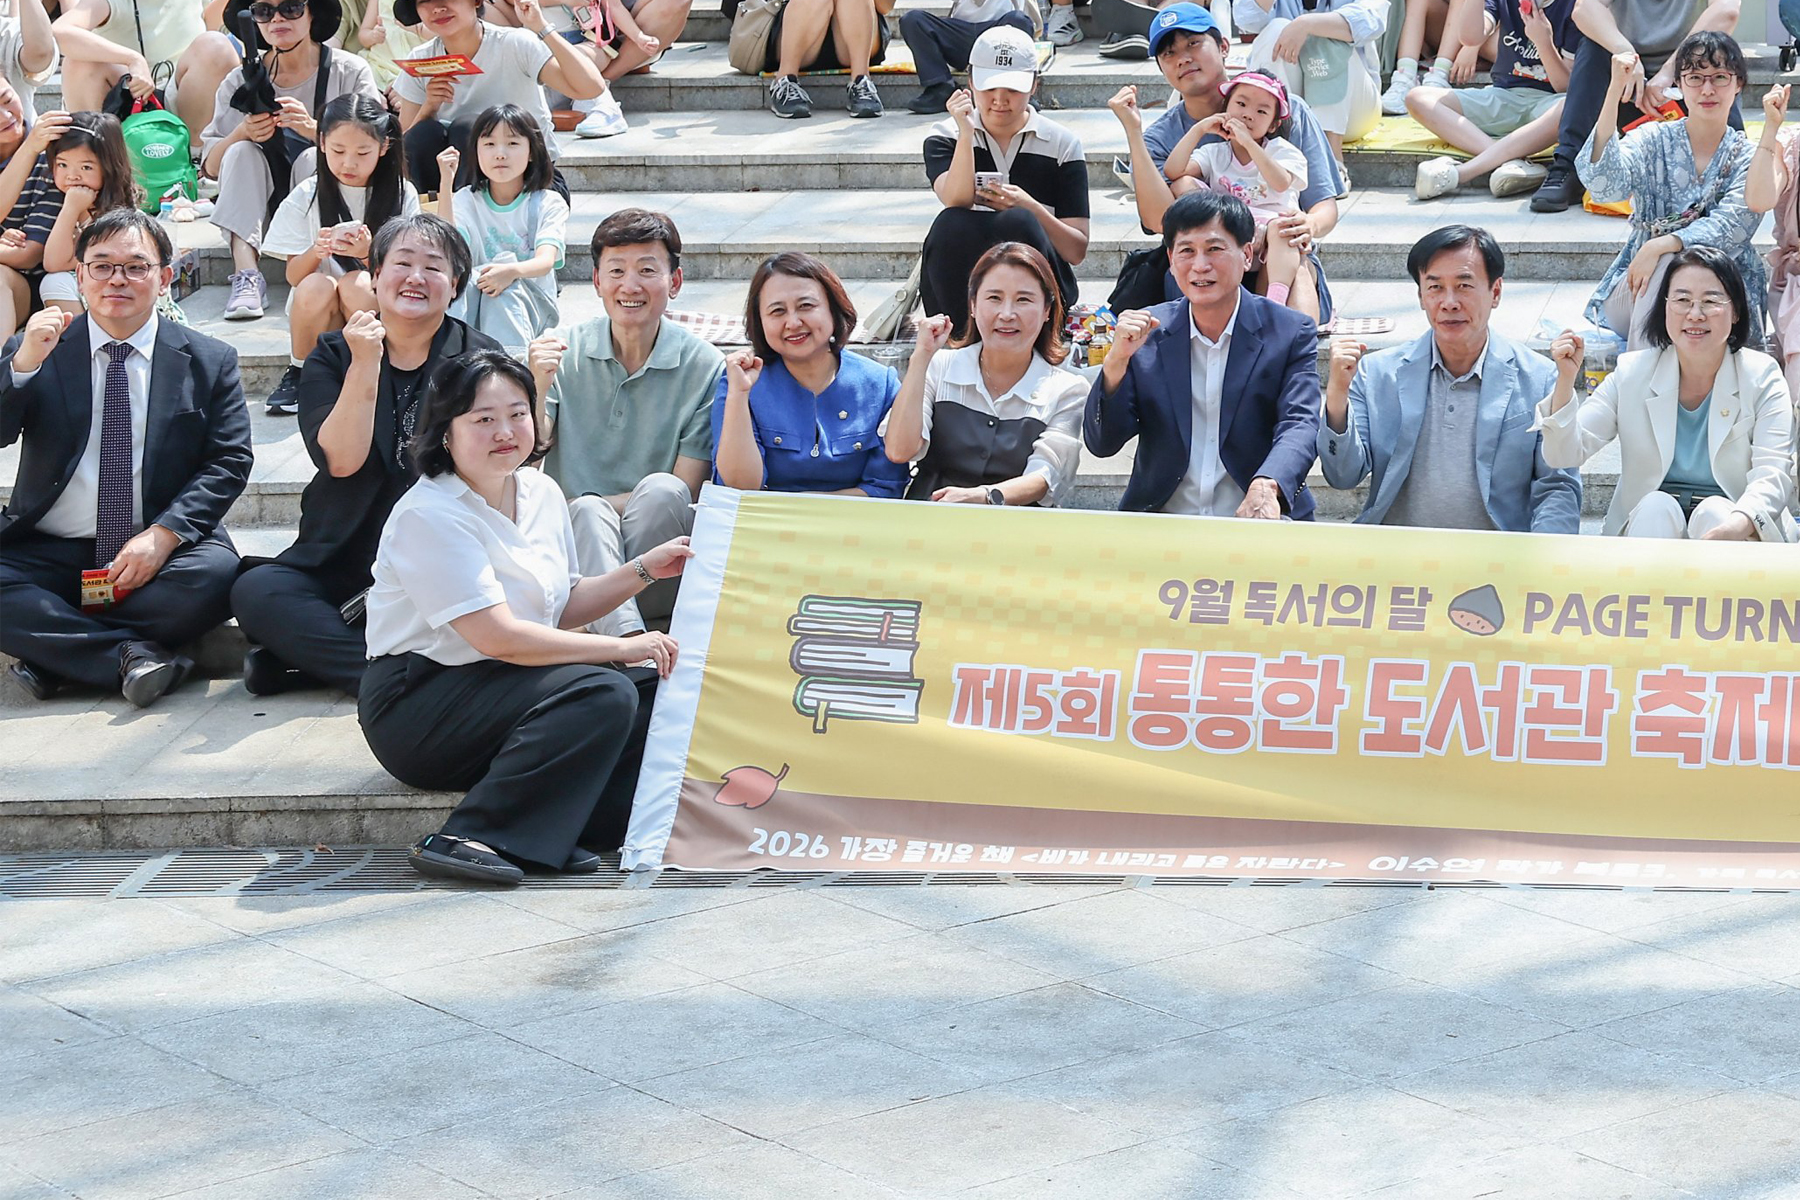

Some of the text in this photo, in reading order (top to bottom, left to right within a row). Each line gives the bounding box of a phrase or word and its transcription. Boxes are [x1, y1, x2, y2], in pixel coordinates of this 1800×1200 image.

[995, 55, 1012, 66] 1934
[1306, 63, 1329, 72] Service
[1308, 57, 1325, 66] Type
[1158, 579, 1233, 625] 9월
[1243, 582, 1374, 628] 독서의
[1389, 586, 1432, 631] 달
[1523, 591, 1650, 638] PAGE
[949, 663, 1121, 741] 제5회
[1130, 650, 1346, 754] 통통한
[1359, 658, 1619, 766] 도서관
[748, 827, 829, 859] 2026
[840, 836, 897, 862] 가장
[901, 840, 974, 863] 즐거운
[979, 845, 1015, 864] 책
[1020, 848, 1089, 865] <비가
[1095, 852, 1178, 868] 내리고
[1234, 856, 1346, 870] 자란다>
[1367, 856, 1485, 872] 이수연
